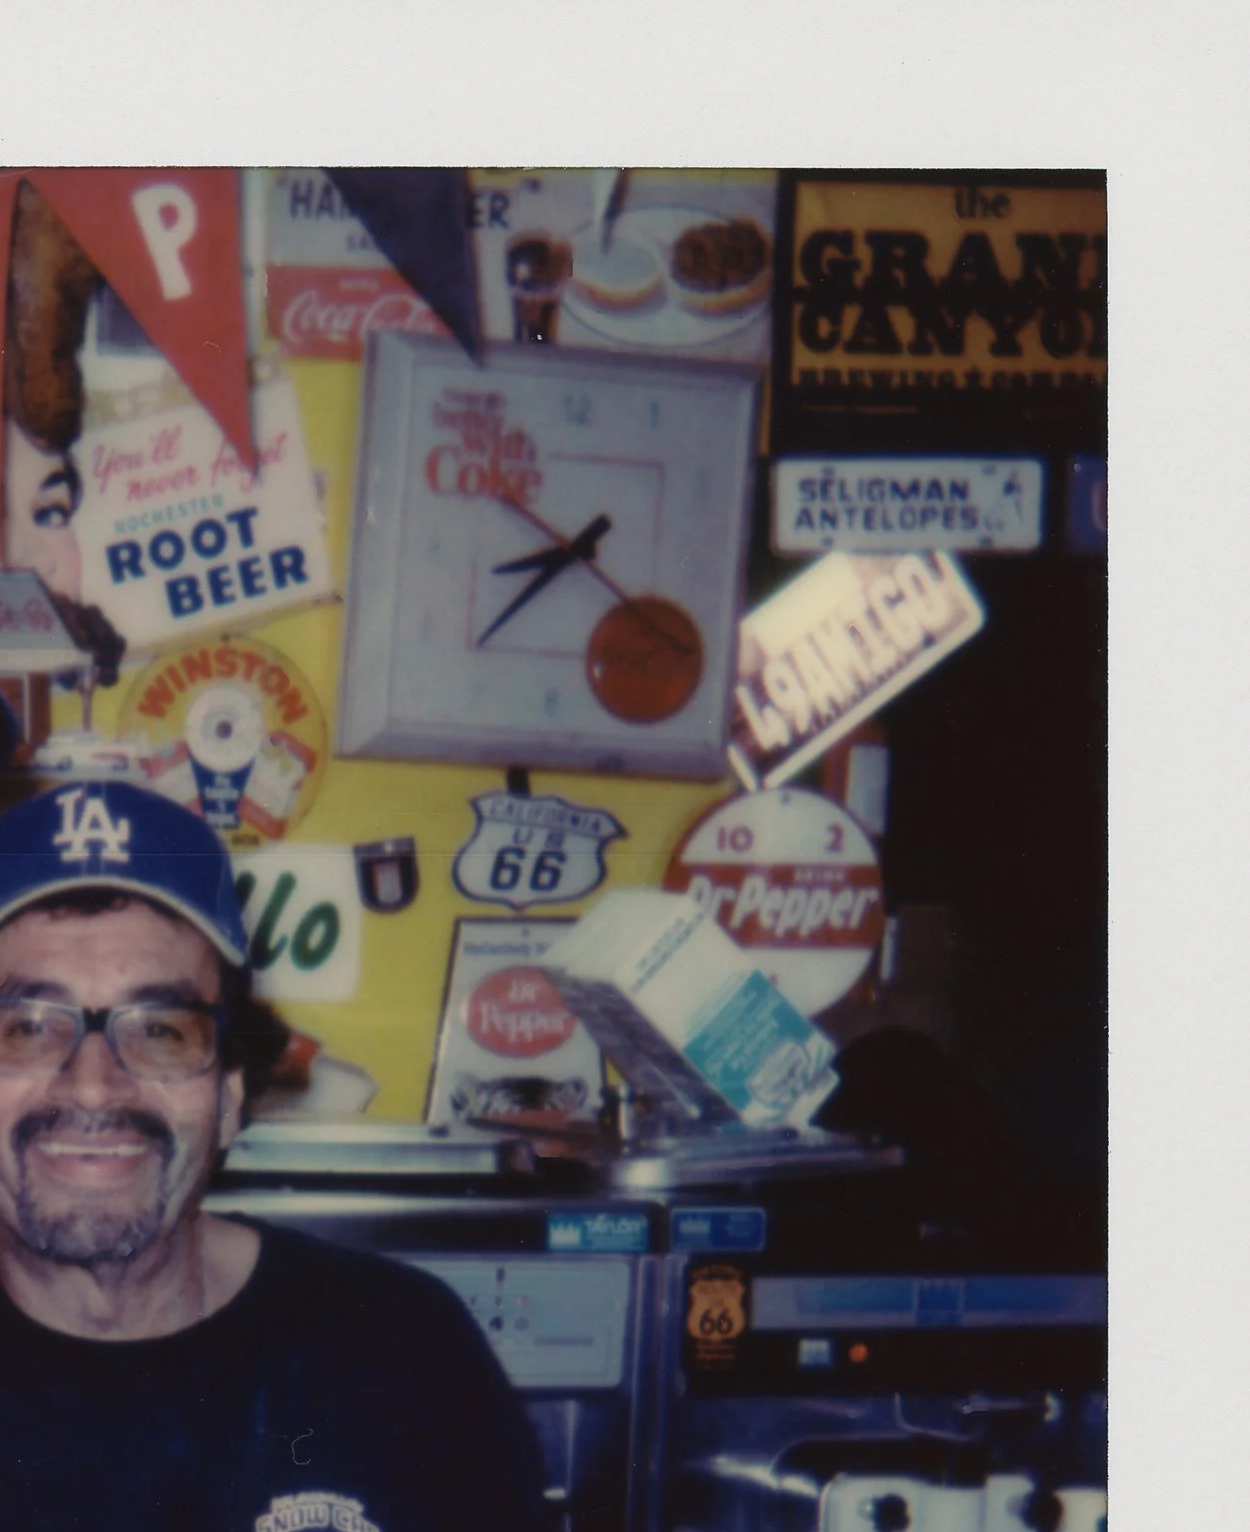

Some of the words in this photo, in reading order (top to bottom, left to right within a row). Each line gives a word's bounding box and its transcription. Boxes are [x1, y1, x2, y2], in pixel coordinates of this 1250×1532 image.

[796, 477, 969, 502] SELIGMAN
[112, 494, 225, 535] ROCHESTER
[794, 505, 979, 533] ANTELOPES
[105, 507, 259, 585] ROOT
[164, 545, 310, 618] BEER
[137, 645, 310, 725] WINSTON
[53, 790, 131, 863] LA
[717, 825, 754, 853] 10
[824, 823, 845, 853] 2
[490, 846, 568, 892] 66
[731, 872, 882, 938] Pepper
[479, 1002, 570, 1042] Pepper
[700, 1308, 734, 1336] 66
